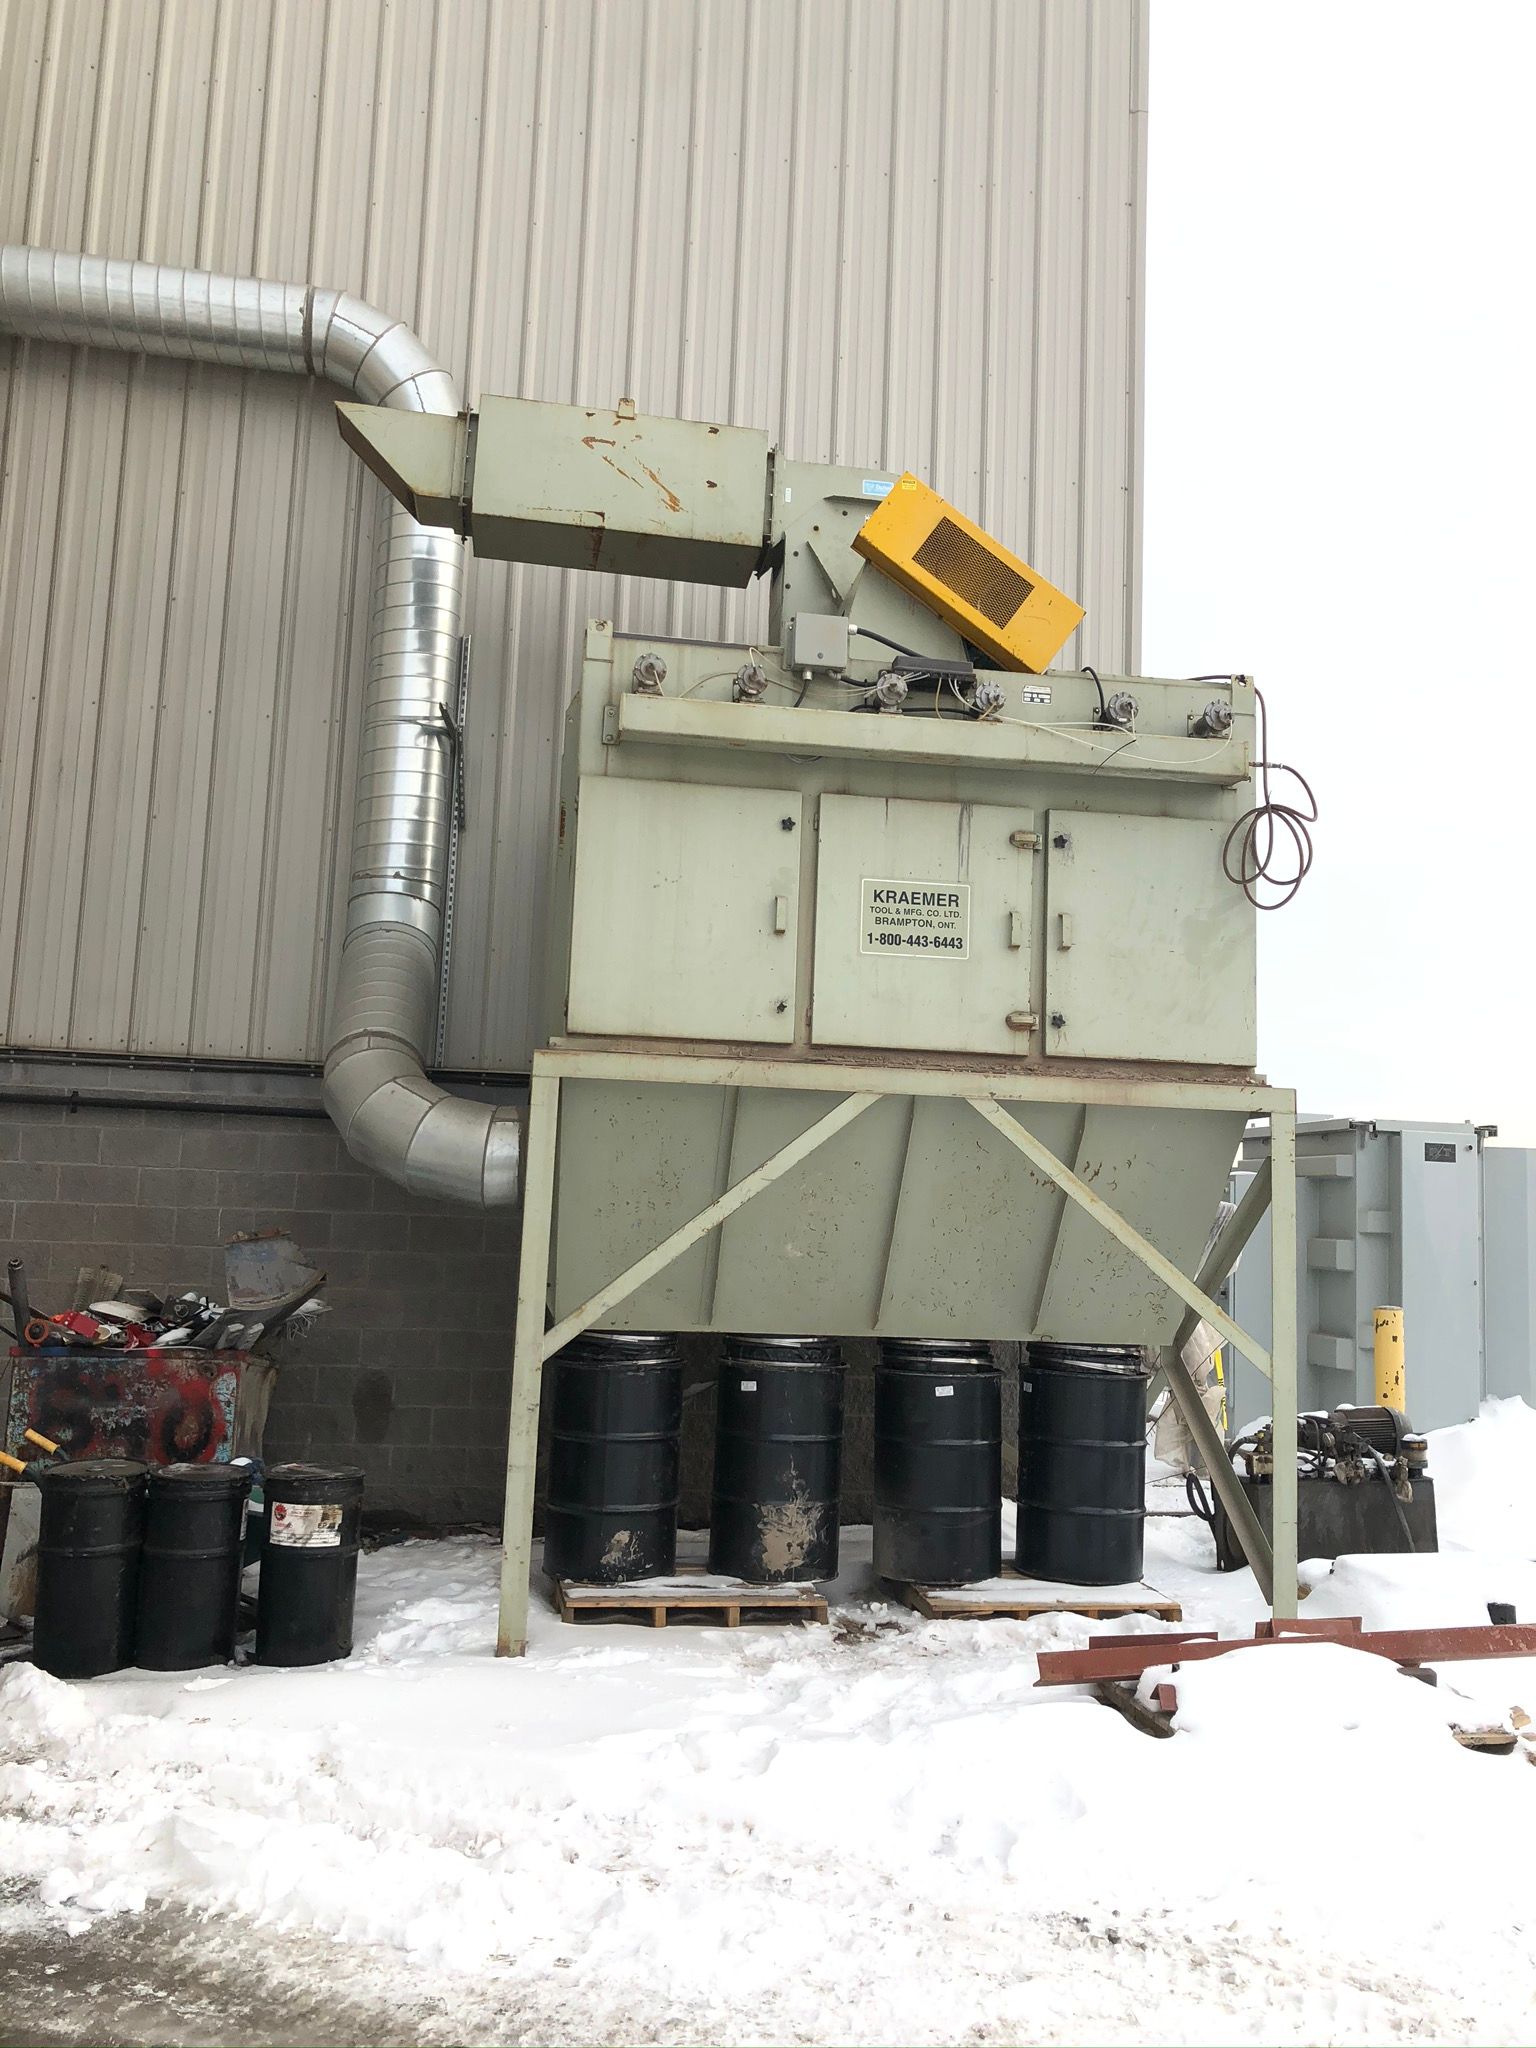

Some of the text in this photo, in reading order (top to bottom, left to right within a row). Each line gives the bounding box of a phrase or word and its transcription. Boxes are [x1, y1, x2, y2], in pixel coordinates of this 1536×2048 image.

[873, 889, 960, 907] KRAEMER
[870, 906, 962, 919] TOOL & MFG. CO. LTD.
[875, 917, 957, 929] BRAMPTON, ONT.
[867, 932, 963, 950] 1-800-443-6443
